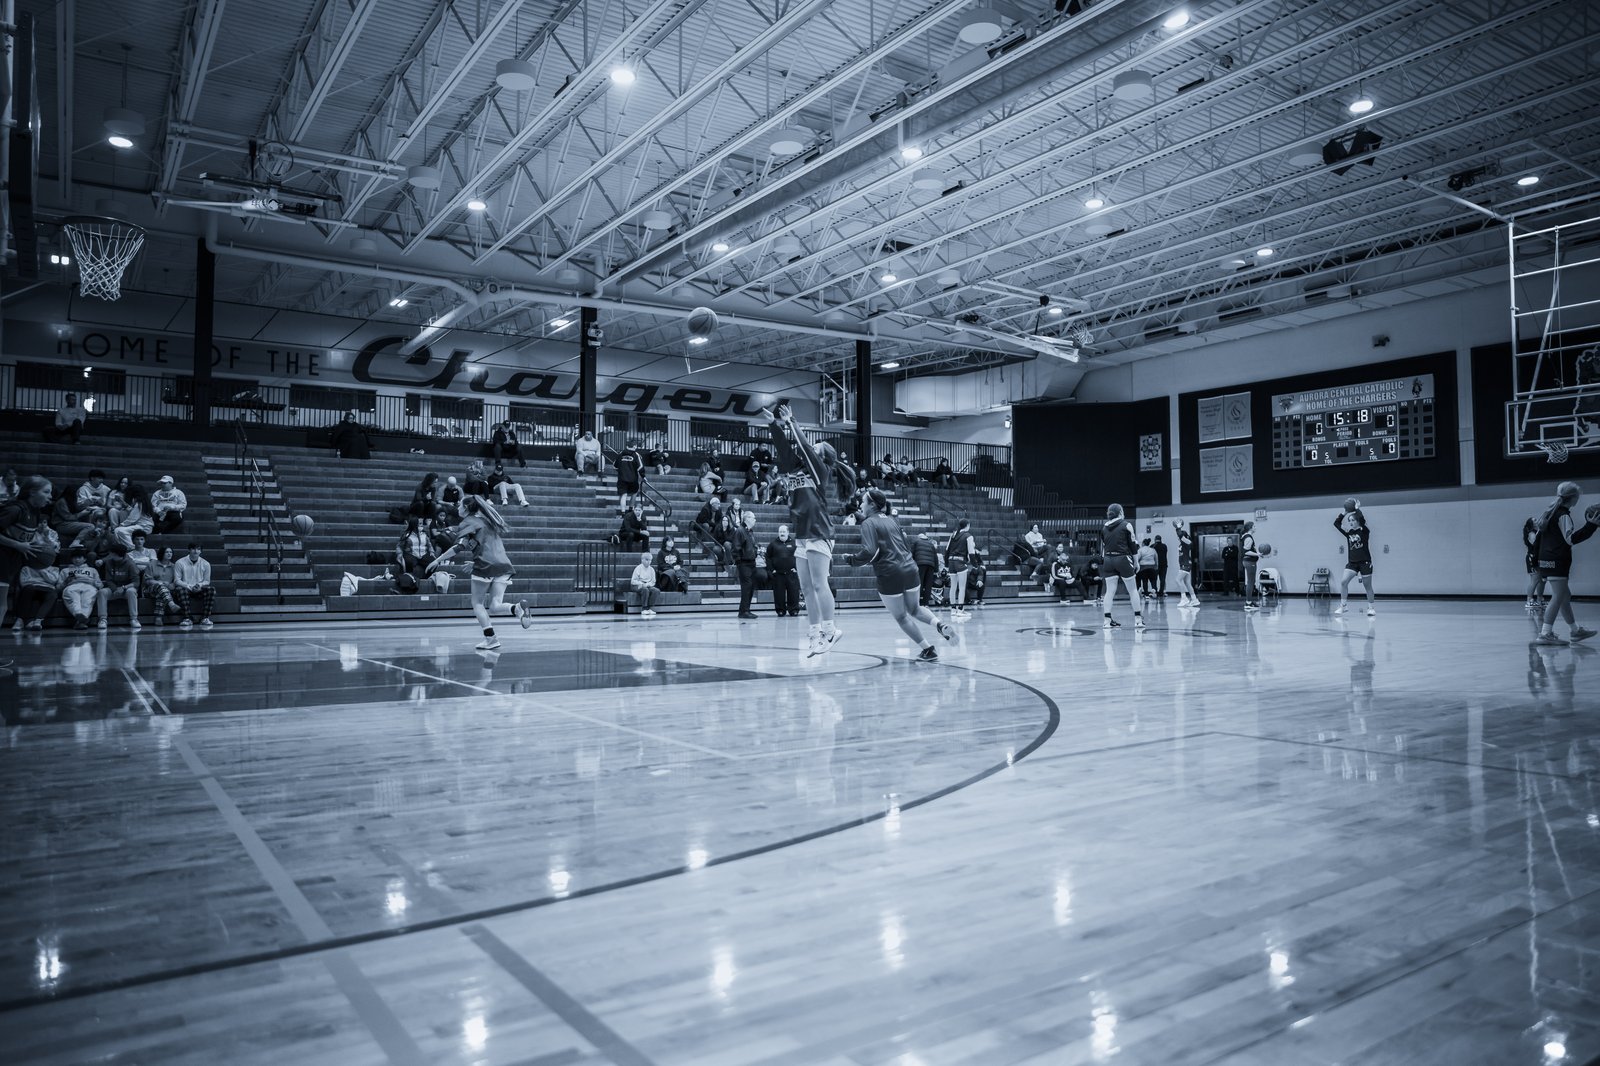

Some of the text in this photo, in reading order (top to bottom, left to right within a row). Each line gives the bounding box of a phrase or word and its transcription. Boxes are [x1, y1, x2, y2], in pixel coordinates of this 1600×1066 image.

[57, 332, 169, 363] HOME
[267, 349, 320, 376] THE
[352, 336, 791, 418] Chager
[1299, 390, 1329, 402] AURORA
[1330, 386, 1364, 398] CENTRAL
[1364, 380, 1404, 394] CATHOLIC
[1306, 392, 1397, 410] HOME OF THE CHARGERS
[1372, 404, 1397, 412] VISITOR
[1305, 414, 1322, 422] HOME
[1333, 409, 1369, 425] 15:18
[1386, 414, 1395, 426] 0
[1315, 422, 1323, 434] 0
[1357, 428, 1361, 438] 1
[1311, 450, 1318, 460] 0
[1388, 444, 1395, 454] 0
